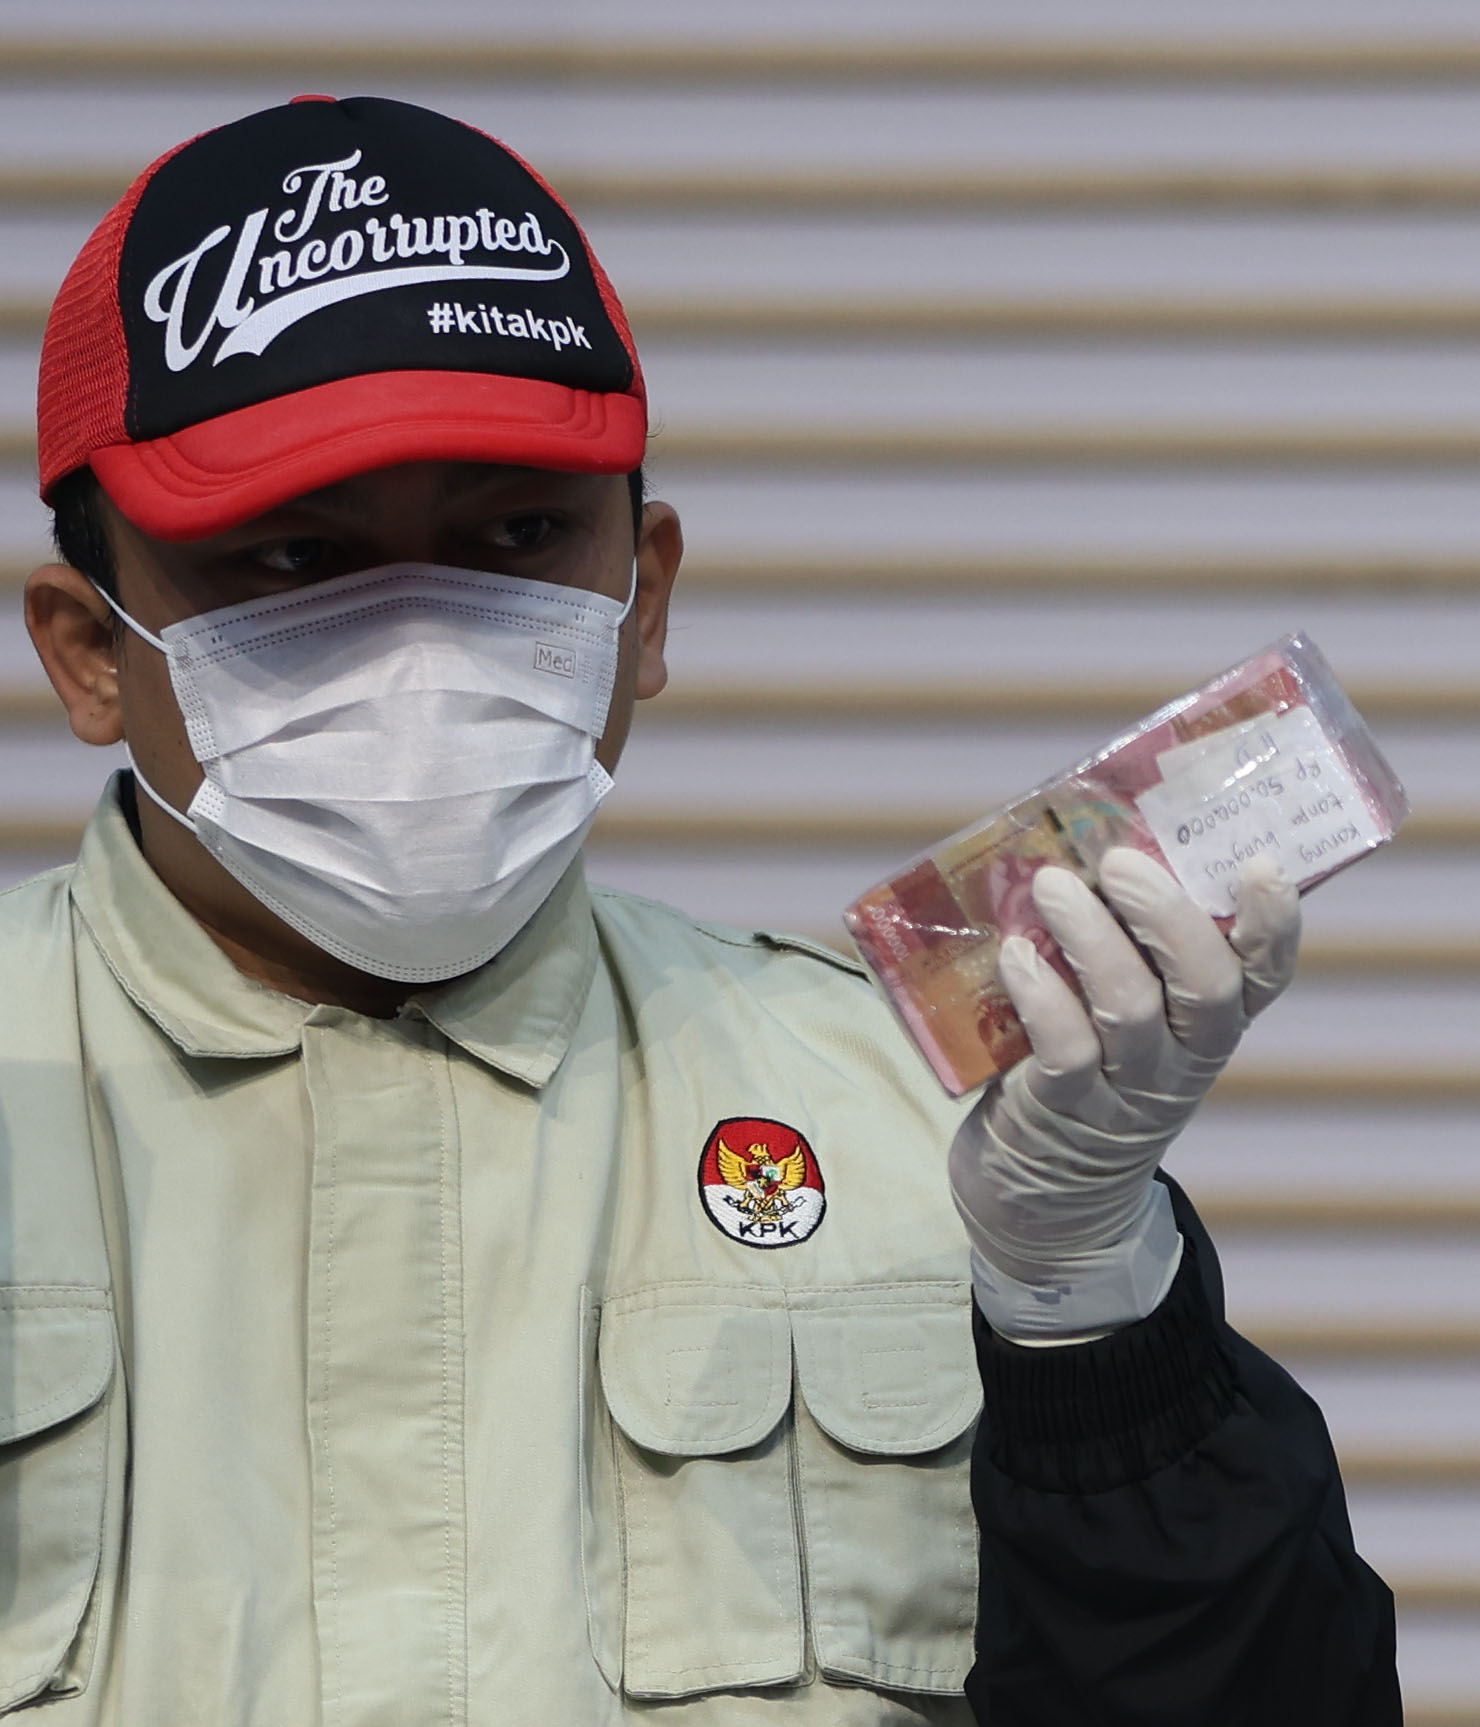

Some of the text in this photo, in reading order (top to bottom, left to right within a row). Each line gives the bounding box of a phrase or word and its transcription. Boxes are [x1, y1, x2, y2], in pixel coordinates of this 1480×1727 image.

[275, 149, 389, 243] The
[143, 208, 570, 371] Uncorrupted
[427, 301, 593, 351] #kitakpk
[538, 648, 573, 673] Med
[739, 1221, 800, 1239] KPK
